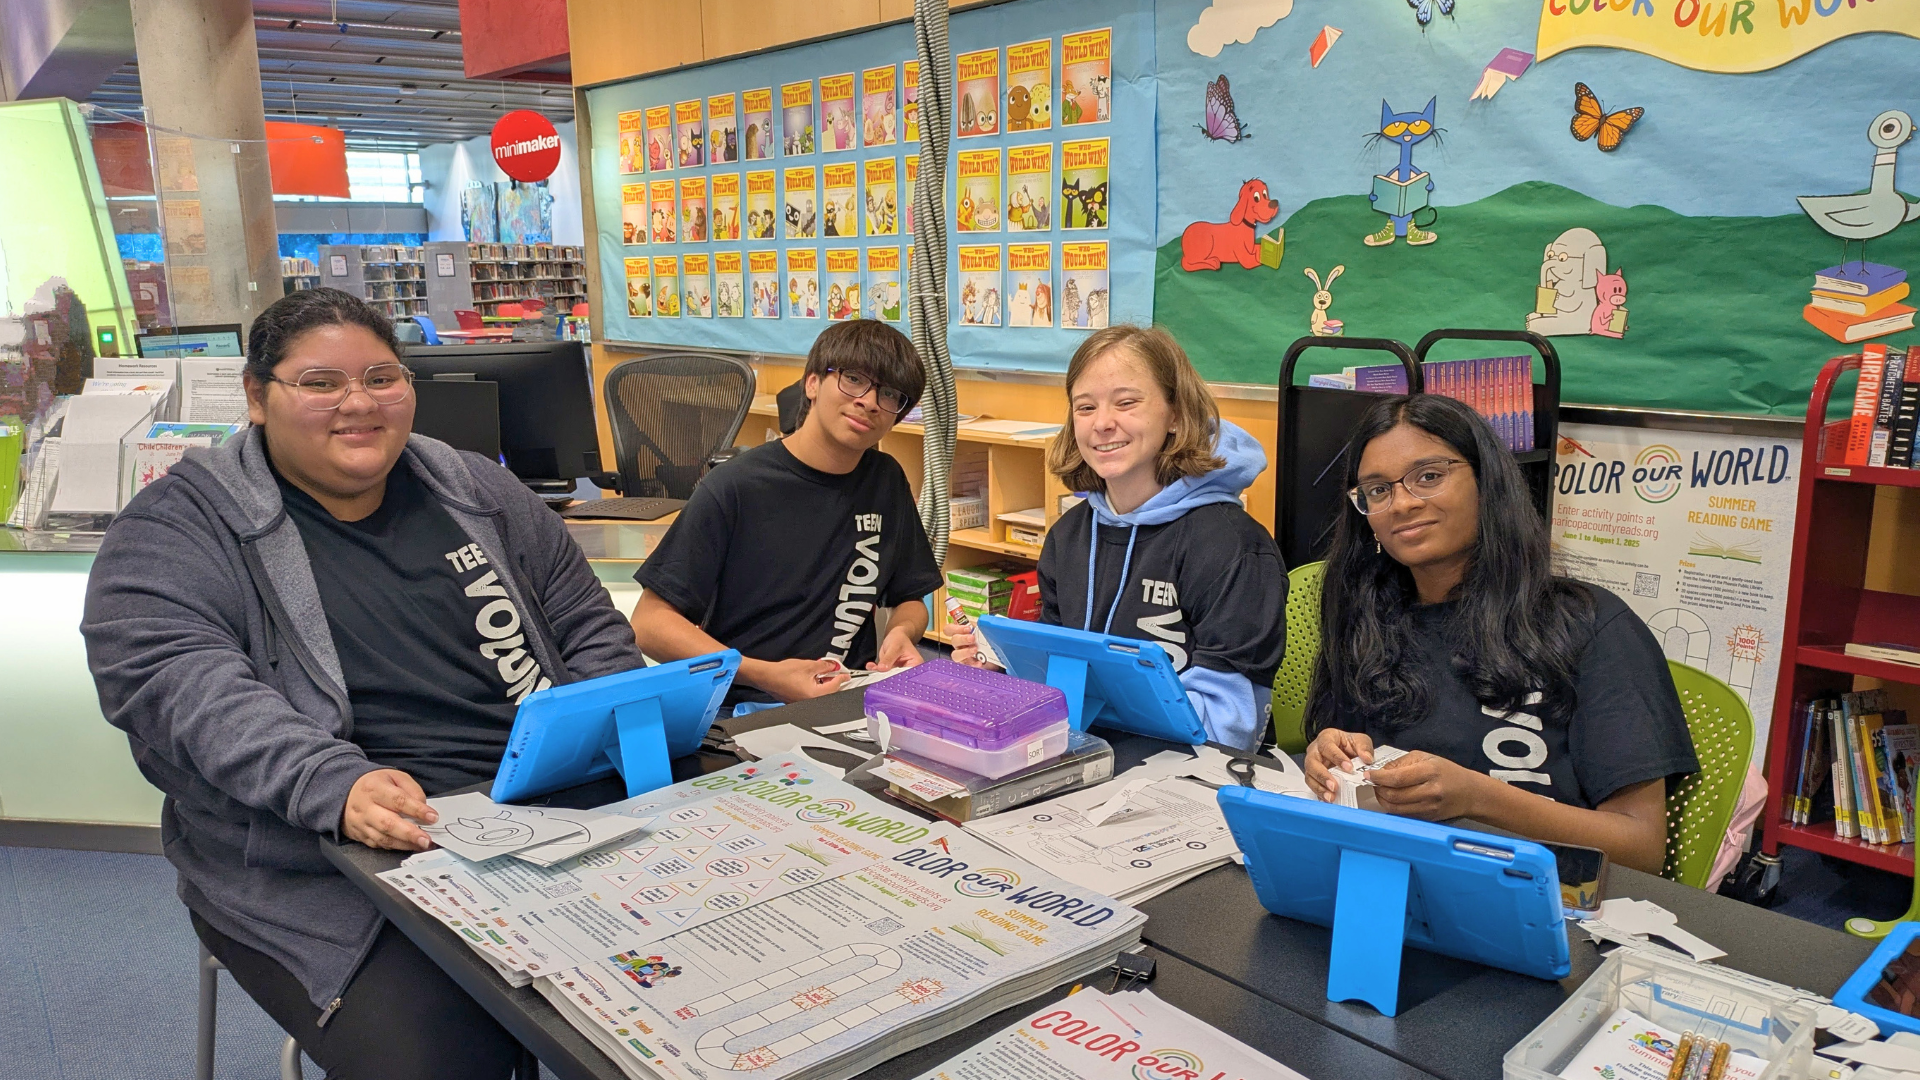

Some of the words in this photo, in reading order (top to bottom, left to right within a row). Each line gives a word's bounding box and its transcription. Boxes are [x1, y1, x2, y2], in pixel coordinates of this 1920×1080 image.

[1674, 0, 1755, 37] OUR
[1009, 53, 1030, 72] WOULD
[1064, 43, 1089, 63] WOULD
[959, 62, 979, 80] WOULD
[495, 135, 559, 159] minimaker
[959, 159, 981, 175] WOULD
[1009, 155, 1030, 173] WOULD
[1064, 150, 1087, 169] WOULD
[960, 254, 982, 270] WOULD
[1009, 253, 1030, 270] WOULD
[1064, 252, 1087, 268] WOULD
[1853, 351, 1883, 417] AIRFRAME
[1885, 355, 1901, 393] PRATCHETT
[1879, 397, 1891, 423] BAXTER
[1899, 387, 1918, 420] DARK
[1850, 420, 1860, 451] CRICHTON
[1857, 423, 1868, 450] MICHAEL
[1892, 428, 1911, 460] LADY
[1632, 465, 1683, 483] OUR
[1691, 445, 1789, 488] WORLD
[957, 504, 980, 516] LAUGH
[1558, 504, 1580, 516] Enter
[1582, 508, 1614, 522] activity
[1617, 512, 1643, 524] points
[1646, 516, 1655, 525] at
[1708, 496, 1756, 512] SUMMER
[855, 513, 882, 532] TEEN
[959, 516, 979, 526] SPEAK
[1688, 511, 1737, 529] READING
[1741, 517, 1773, 532] GAME
[1562, 531, 1577, 539] June
[1593, 535, 1614, 544] August
[1624, 539, 1640, 547] 2025
[445, 543, 488, 573] TEE
[1679, 559, 1696, 568] Prizes
[826, 535, 880, 662] VOLUN
[1142, 578, 1179, 606] TEEN
[464, 570, 552, 705] VOLUN
[1736, 642, 1756, 650] Points!
[1028, 748, 1044, 760] SORT
[732, 781, 813, 808] COLOR
[805, 803, 848, 818] OUR
[838, 812, 929, 844] WORLD
[855, 875, 870, 883] June
[878, 886, 897, 897] August
[901, 899, 918, 908] 2025
[861, 867, 943, 912] aricopacountyreads.org
[890, 871, 919, 887] activity
[916, 884, 942, 899] points
[892, 848, 969, 878] OLOR
[961, 873, 1014, 893] OUR
[1005, 886, 1114, 927] WORLD
[974, 908, 1017, 933] READING
[1015, 928, 1049, 947] GAME
[1005, 909, 1049, 932] SUMMER
[674, 1009, 688, 1020] Here
[680, 1006, 697, 1019] Start
[1016, 1028, 1029, 1038] How
[1037, 1039, 1050, 1051] Play
[1031, 1010, 1141, 1063] COLOR
[1137, 1055, 1199, 1080] OUR
[1628, 1043, 1672, 1068] Summer
[1616, 1063, 1639, 1076] Friends
[1628, 1063, 1640, 1072] free
[1639, 1062, 1652, 1071] This
[1734, 1067, 1757, 1078] you
